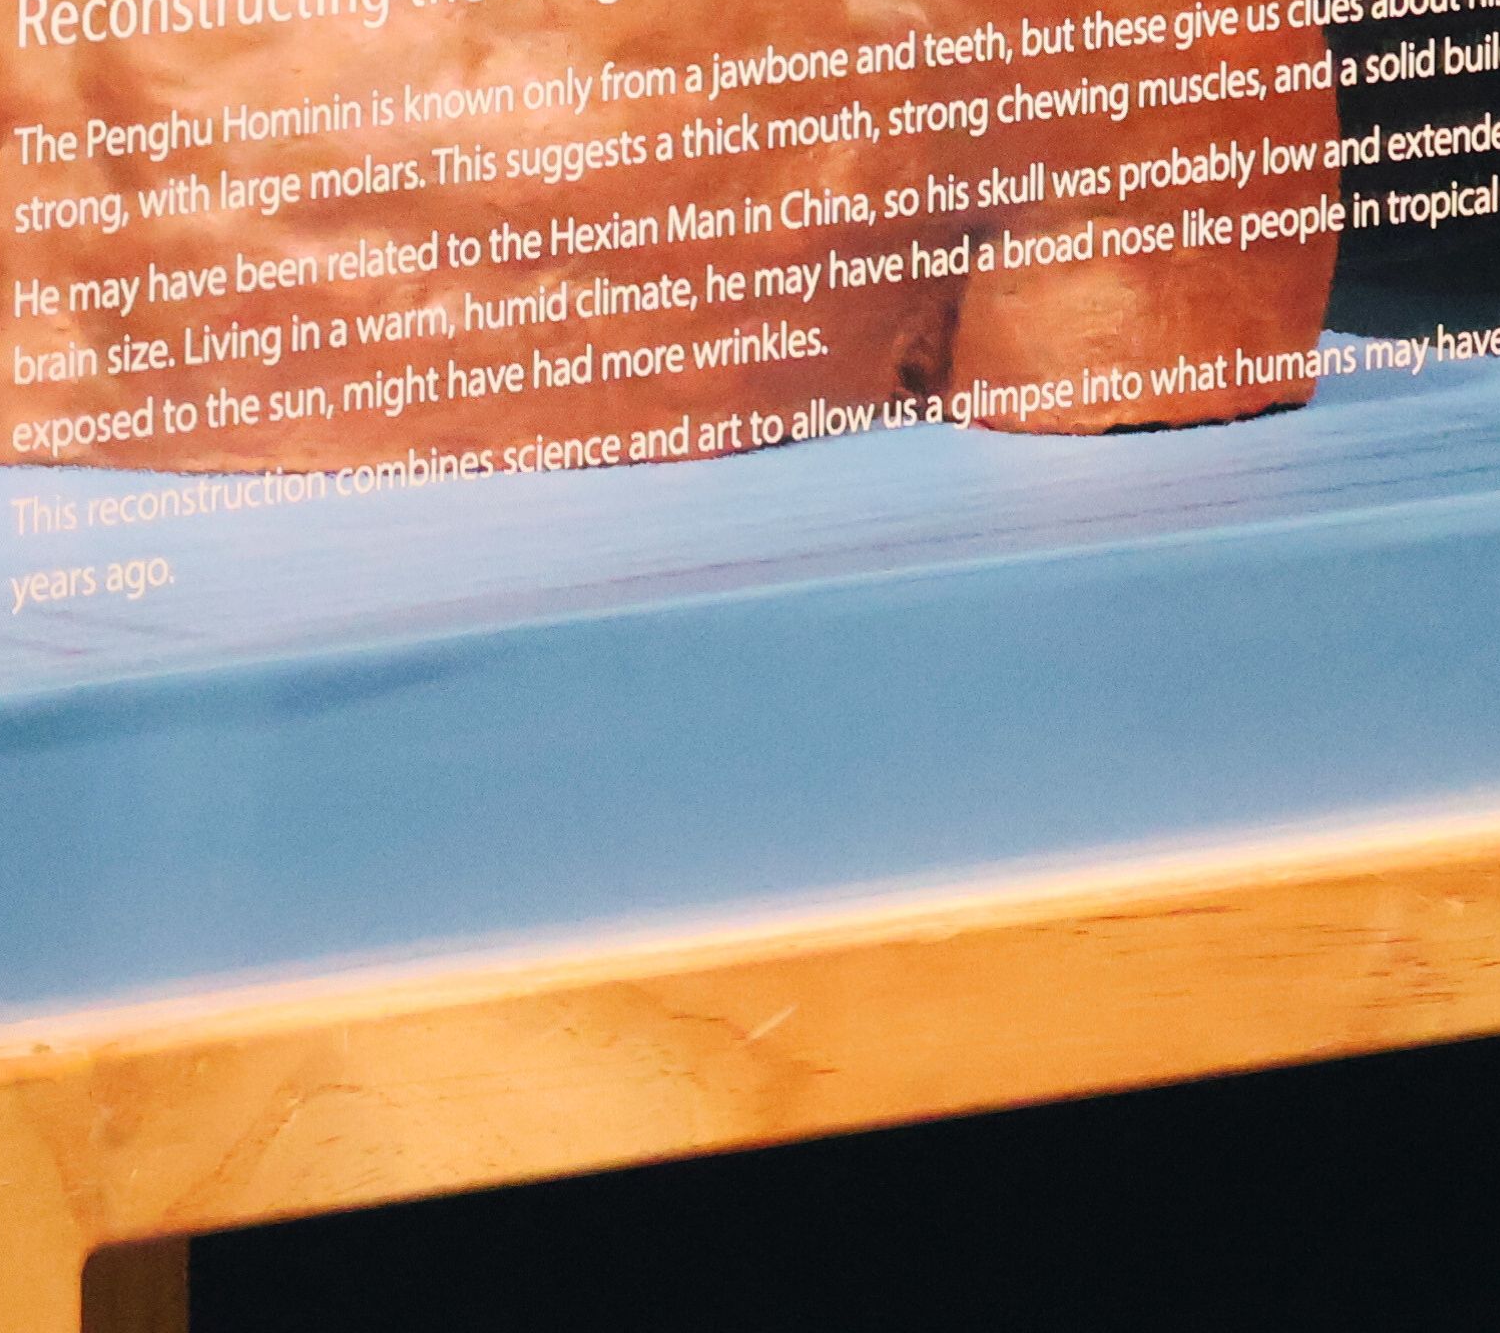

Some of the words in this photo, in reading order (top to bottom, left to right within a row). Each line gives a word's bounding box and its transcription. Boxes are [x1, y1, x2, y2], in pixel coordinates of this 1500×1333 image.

[14, 124, 76, 164] The
[87, 109, 212, 161] Penghu
[223, 93, 361, 142] Hominin
[372, 90, 394, 126] is
[404, 83, 514, 122] known
[523, 66, 592, 114] only
[601, 61, 675, 101] from
[685, 64, 701, 92] a
[708, 44, 847, 101] jawbone
[856, 30, 914, 73] and
[923, 21, 1012, 67] teeth,
[1021, 17, 1074, 56] but
[1082, 10, 1165, 49] these
[1174, 1, 1238, 50] give
[1246, 1, 1279, 32] us
[15, 194, 128, 233] strong,
[138, 173, 209, 218] with
[220, 169, 299, 215] large
[310, 154, 426, 199] molars.
[431, 143, 496, 184] This
[506, 131, 646, 183] suggests
[655, 132, 672, 160] a
[682, 112, 759, 157] thick
[767, 100, 879, 148] mouth,
[888, 97, 988, 136] strong
[997, 77, 1128, 123] chewing
[1138, 60, 1266, 108] muscles,
[1274, 49, 1331, 92] and
[1339, 57, 1357, 86] a
[1365, 37, 1435, 83] solid
[14, 277, 57, 318] He
[69, 276, 139, 317] may
[148, 262, 225, 301] have
[236, 252, 317, 291] been
[327, 230, 437, 281] related
[446, 233, 481, 267] to
[489, 222, 541, 262] the
[551, 212, 657, 255] Hexian
[667, 203, 735, 243] Man
[744, 197, 772, 233] in
[780, 188, 875, 229] China,
[884, 187, 918, 218] so
[927, 173, 969, 213] his
[977, 161, 1044, 207] skull
[1051, 165, 1110, 198] was
[1119, 140, 1255, 201] probably
[1263, 136, 1316, 175] low
[1323, 124, 1379, 168] and
[14, 340, 96, 384] brain
[107, 334, 175, 374] size.
[184, 321, 281, 365] Living
[291, 314, 320, 351] in
[330, 318, 346, 347] a
[356, 306, 454, 343] warm,
[464, 280, 567, 330] humid
[576, 274, 697, 318] climate,
[706, 264, 745, 302] he
[754, 262, 821, 302] may
[828, 249, 903, 288] have
[911, 234, 969, 279] had
[978, 243, 994, 271] a
[1003, 220, 1093, 268] broad
[1102, 222, 1174, 257] nose
[1182, 207, 1232, 247] like
[1240, 193, 1344, 250] people
[1353, 192, 1379, 228] in
[1387, 174, 1498, 229] tropical
[10, 494, 77, 535] This
[87, 464, 326, 527] reconstruction
[334, 447, 493, 495] combines
[503, 434, 620, 474] science
[629, 414, 688, 460] and
[698, 413, 742, 451] art
[750, 410, 783, 445] to
[790, 397, 874, 440] allow
[882, 397, 916, 427] us
[925, 395, 942, 422] a
[951, 379, 1073, 429] glimpse
[1082, 367, 1142, 404] into
[1150, 355, 1227, 395] what
[1235, 345, 1356, 386] humans
[1365, 336, 1429, 375] may
[12, 395, 153, 458] exposed
[162, 398, 197, 433] to
[205, 387, 260, 427] the
[269, 386, 333, 421] sun,
[343, 364, 438, 416] might
[447, 359, 523, 398] have
[533, 343, 592, 389] had
[601, 344, 684, 380] more
[692, 320, 828, 369] wrinkles.
[11, 566, 97, 615] years
[105, 557, 175, 600] ago.
